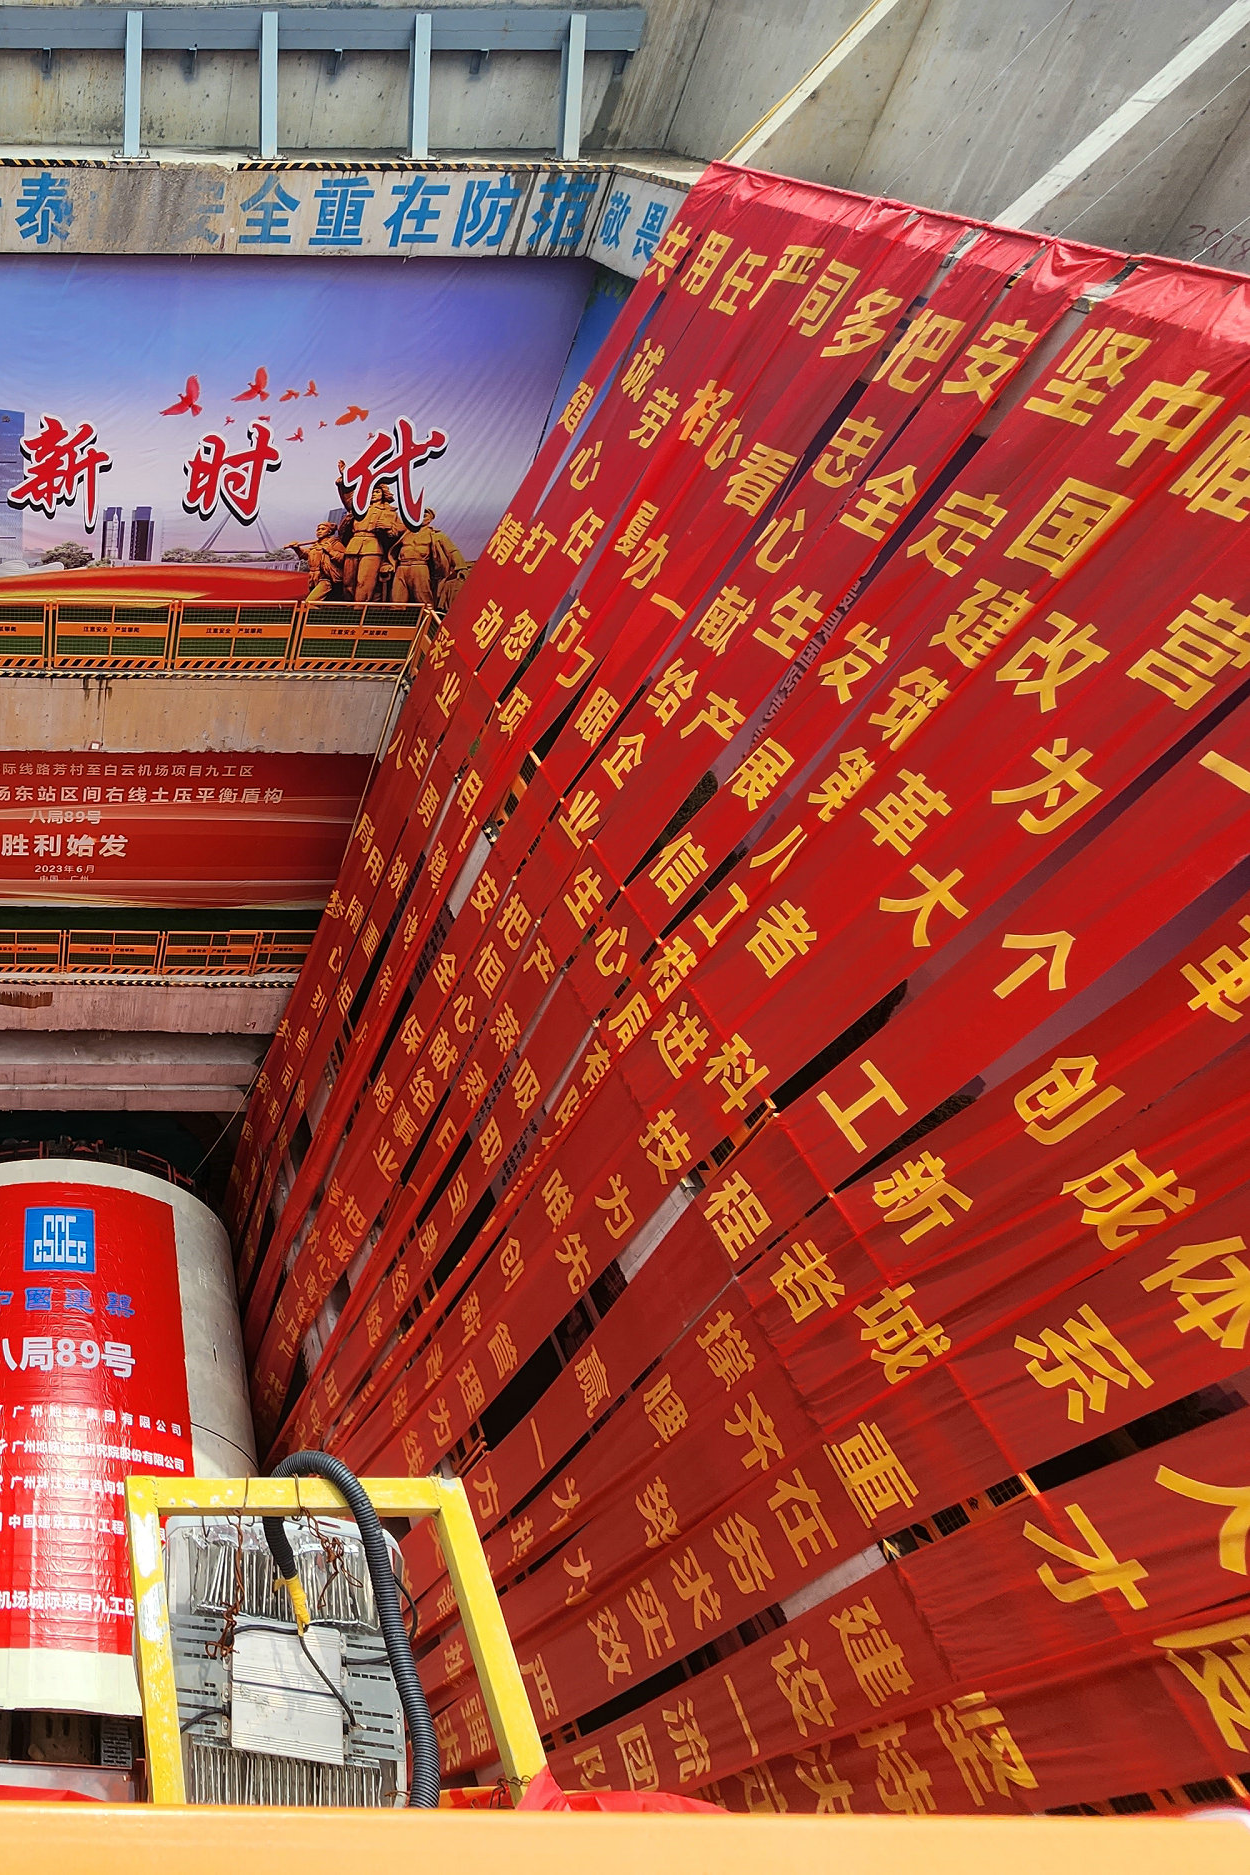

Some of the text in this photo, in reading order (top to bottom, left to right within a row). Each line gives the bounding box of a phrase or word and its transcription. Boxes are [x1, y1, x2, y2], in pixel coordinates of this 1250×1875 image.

[602, 190, 671, 259] 敬畏
[559, 311, 963, 848] 把忠心献给企业
[575, 270, 902, 744] 多看一眼
[595, 301, 1150, 976] 坚定发展信心
[680, 320, 1036, 740] 安全生产
[0, 834, 129, 857] 胜利始发
[29, 809, 102, 825] 八局89号
[377, 895, 531, 1172] 把恒心献给事业
[556, 1033, 769, 1293] 科技为先
[588, 1422, 918, 1681] 重在务求实效
